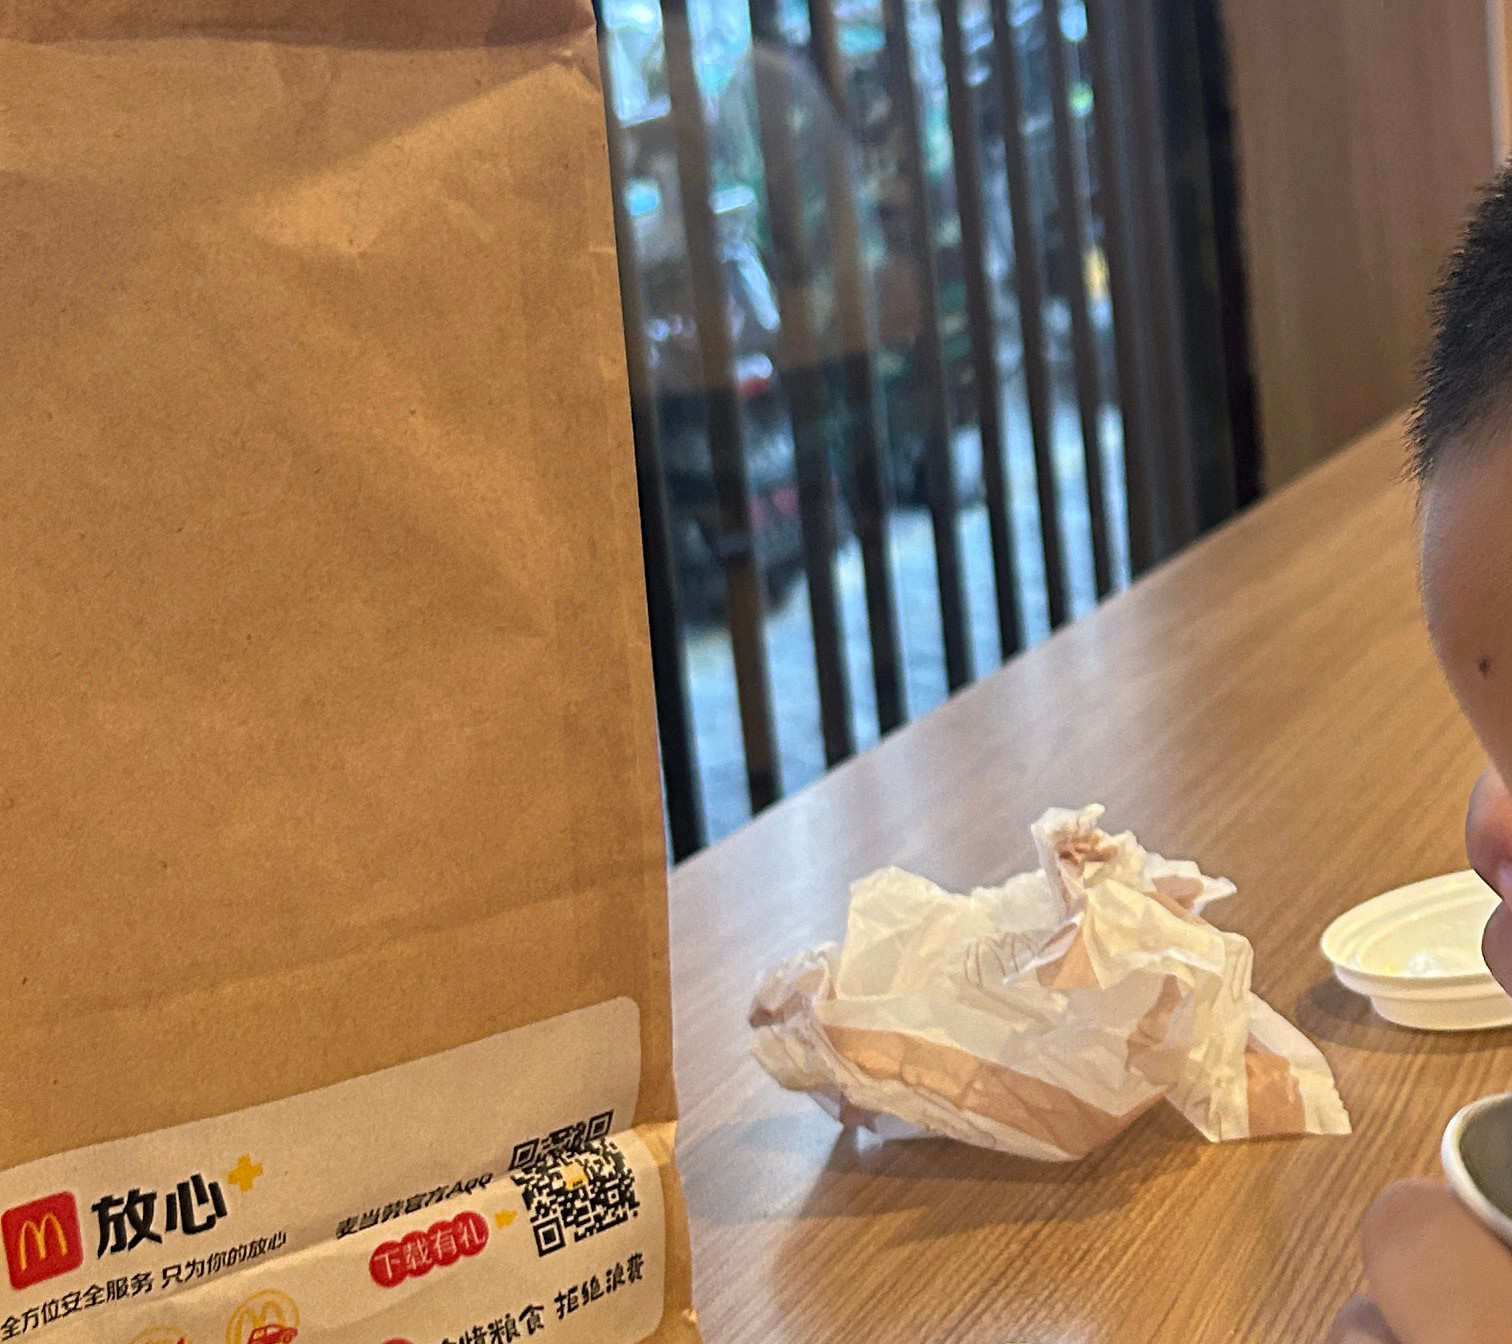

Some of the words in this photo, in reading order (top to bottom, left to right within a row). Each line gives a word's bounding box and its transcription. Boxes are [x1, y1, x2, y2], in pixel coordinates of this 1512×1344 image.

[373, 1216, 486, 1281] 下载有礼
[0, 1270, 153, 1342] 全方位安全服务
[162, 1230, 287, 1289] 只为你的放心
[553, 1252, 646, 1320] 拒绝浪费
